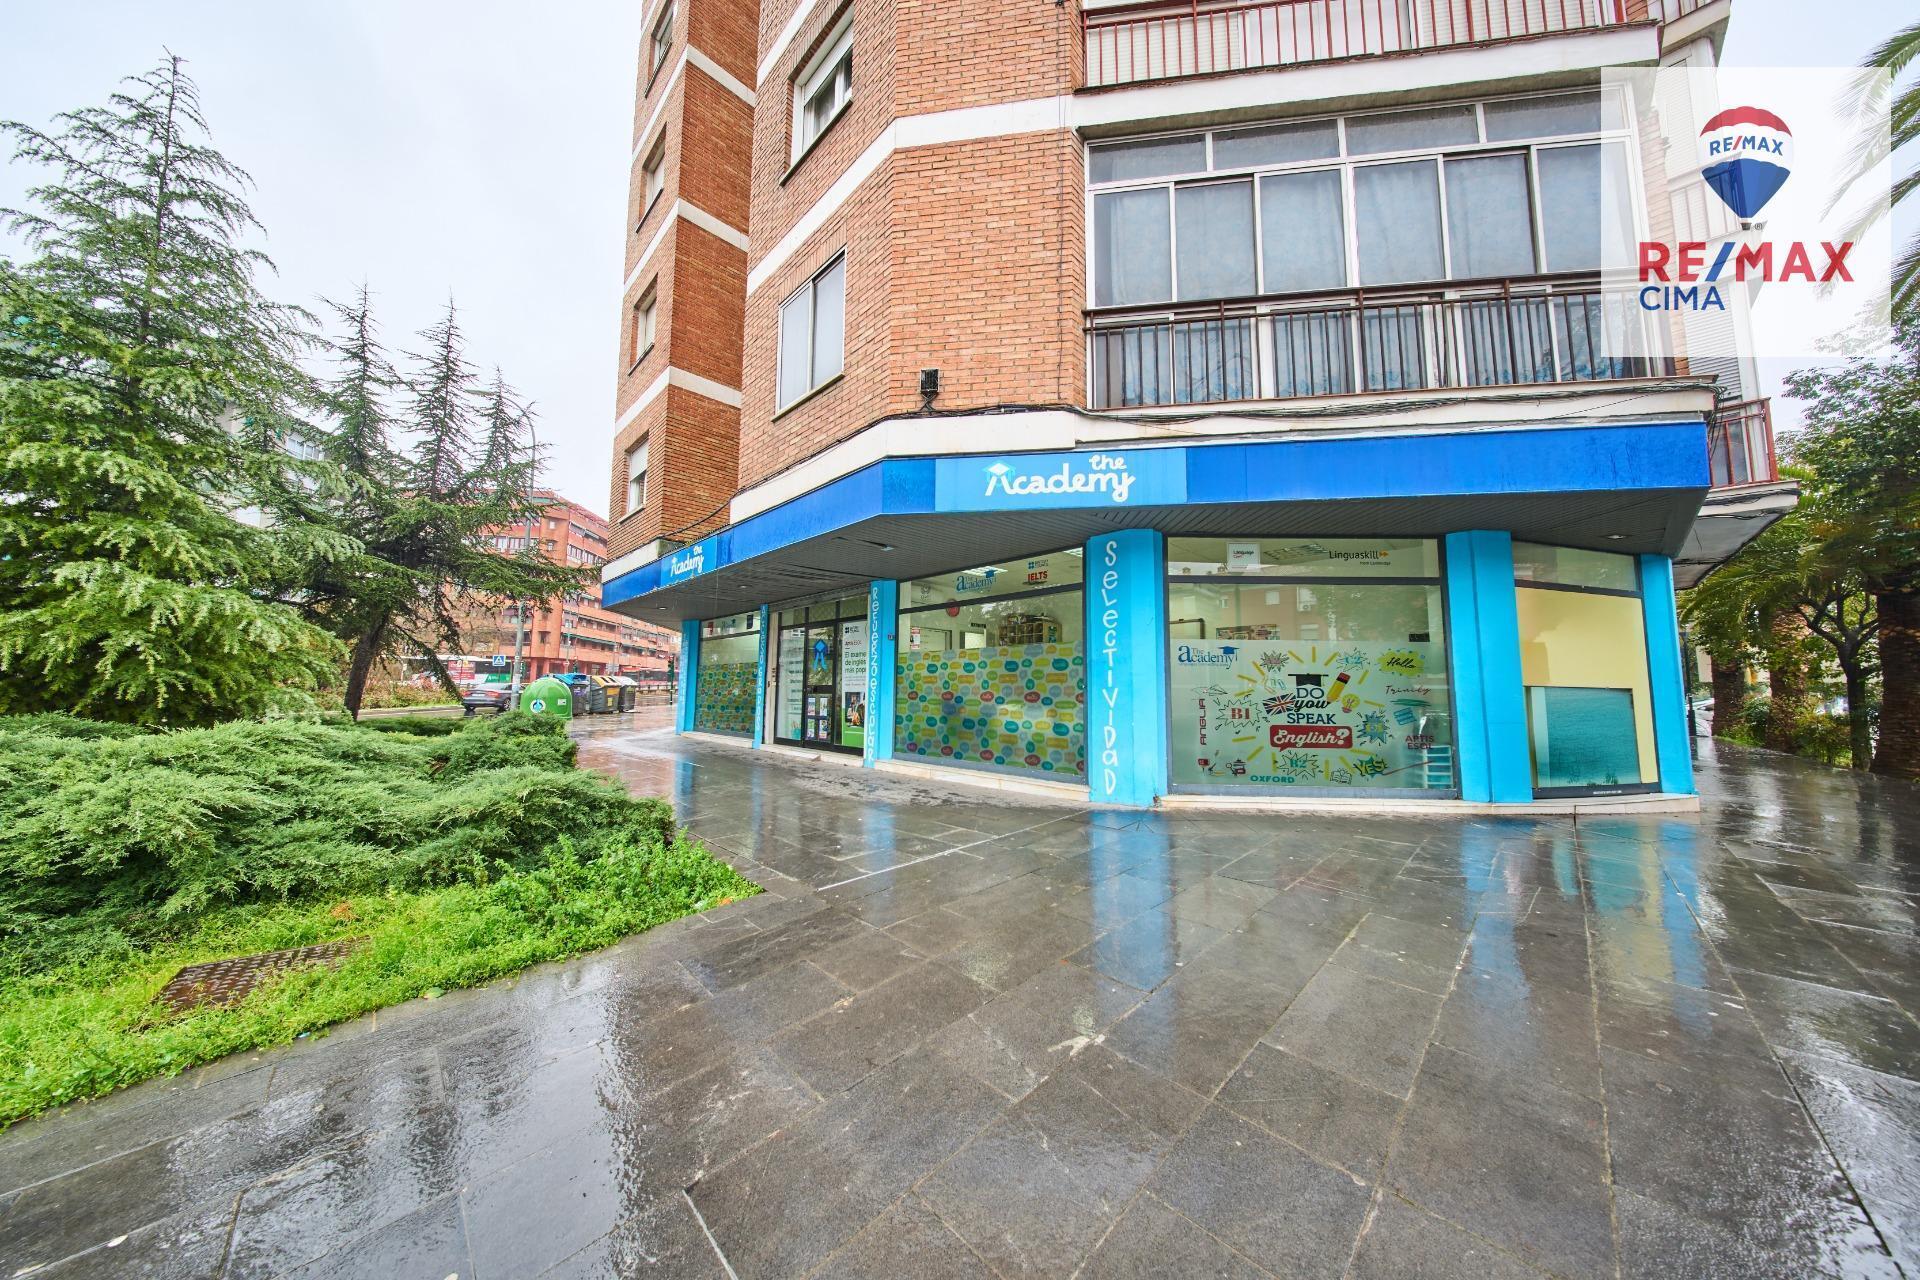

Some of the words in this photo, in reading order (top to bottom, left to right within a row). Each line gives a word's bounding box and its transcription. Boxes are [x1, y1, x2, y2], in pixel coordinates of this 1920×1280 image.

[1089, 454, 1127, 471] the
[984, 462, 1136, 502] Academy
[1328, 550, 1379, 561] Linguaskill
[1027, 570, 1048, 581] IELTS
[1178, 645, 1234, 669] academy
[1296, 687, 1325, 699] DO
[1385, 685, 1431, 696] Trinity
[1293, 699, 1330, 712] you
[1231, 707, 1250, 719] B1
[1287, 713, 1336, 724] SPEAK
[1198, 698, 1207, 745] ANGLIA
[1273, 728, 1350, 748] English?
[1407, 742, 1434, 750] ESOL
[1250, 775, 1295, 784] OXFORD
